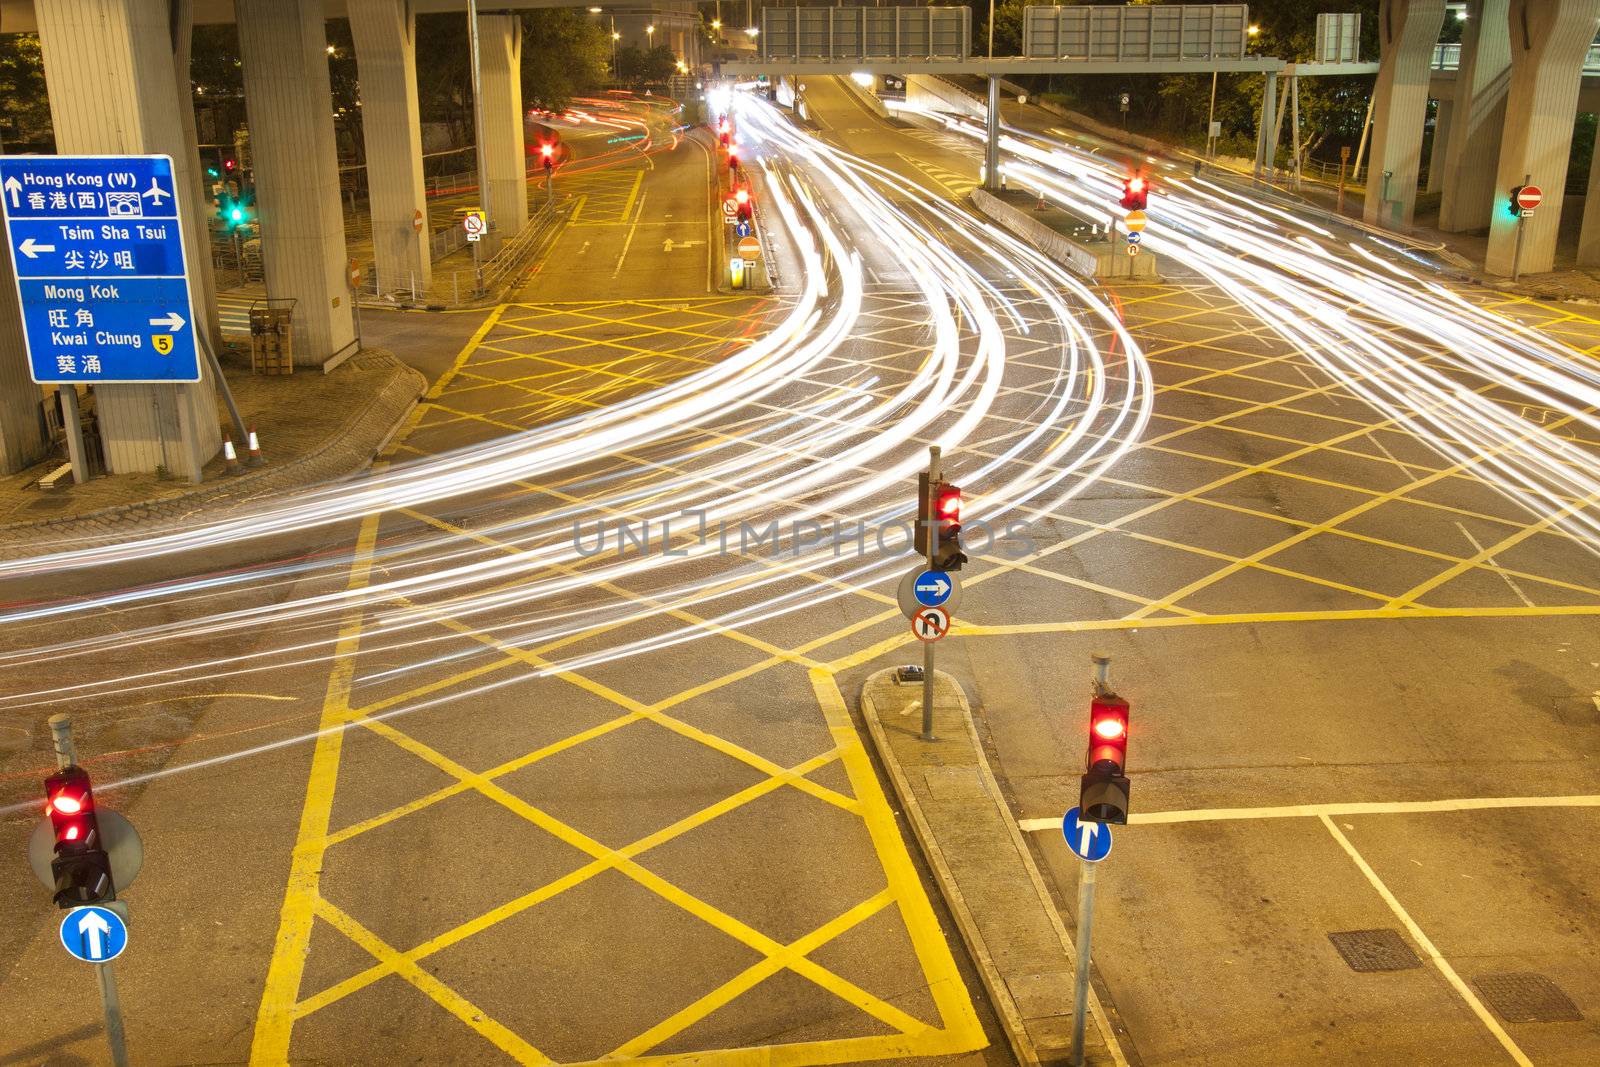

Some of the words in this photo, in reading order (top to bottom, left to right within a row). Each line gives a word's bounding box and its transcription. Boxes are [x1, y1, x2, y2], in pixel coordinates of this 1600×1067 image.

[23, 172, 63, 189] Hong
[66, 173, 103, 188] Kong
[108, 172, 137, 188] (W)
[59, 225, 95, 240] Tsim
[101, 225, 130, 240] Sha
[136, 225, 167, 240] Tsui
[64, 250, 135, 270] 尖沙咀
[44, 285, 85, 302] Mong
[90, 285, 120, 299] Kok
[48, 308, 94, 328] 旺角
[51, 331, 88, 346] Kwai
[95, 331, 142, 348] Chung
[158, 338, 169, 351] 5
[56, 355, 102, 374] 葵涌
